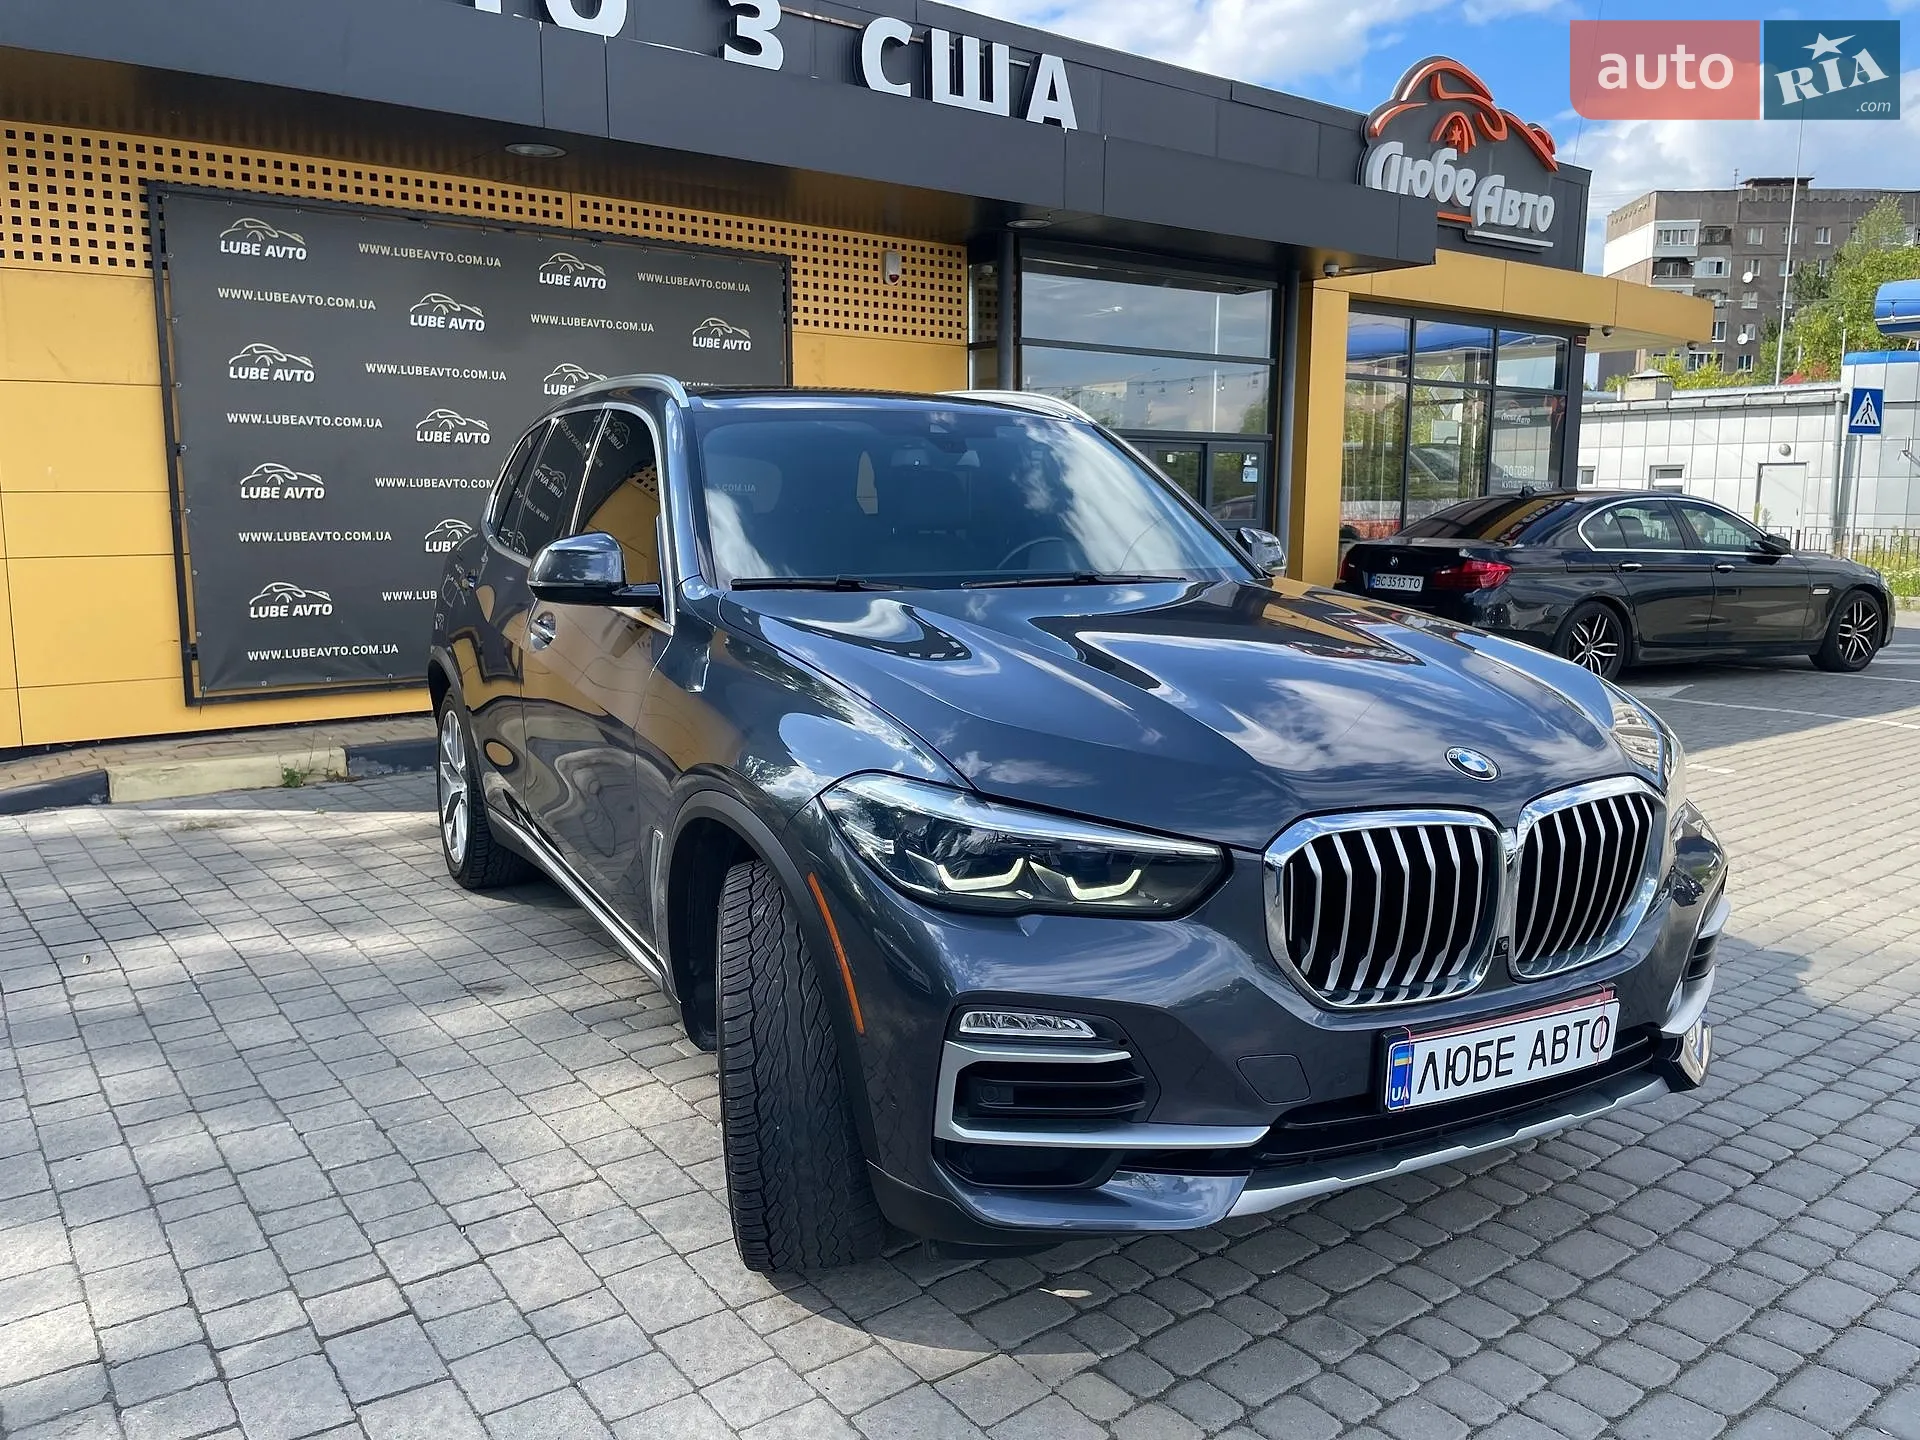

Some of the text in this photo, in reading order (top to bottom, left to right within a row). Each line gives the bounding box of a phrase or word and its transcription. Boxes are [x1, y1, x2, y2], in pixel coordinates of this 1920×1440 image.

[861, 17, 1077, 130] США
[220, 240, 307, 260] LUBE AVTO
[359, 243, 501, 267] WWW.LUBEAVTO.COM.UA
[539, 272, 606, 290] LUBE AVTO
[638, 272, 750, 292] WWW.LUBEAVTO.COM.UA
[218, 287, 376, 310] WWW.LUBEAVTO.COM.UA
[410, 314, 485, 331] LUBE AVTO
[531, 314, 654, 332] WWW.LUBEAVTO.COM.UA
[692, 337, 751, 351] LUBE AVTO
[229, 366, 314, 382] LUBE AVTO
[366, 363, 506, 381] WWW.LUBEAVTO.COM.UA
[227, 413, 383, 428] WWW.LUBEAVTO.COM.UA
[417, 431, 490, 444] LUBE AVTO
[375, 477, 494, 489] WWW.LUBEAVTO.COM
[241, 487, 324, 499] LUBE AVTO
[239, 531, 392, 542] WWW.LUBEAVTO.COM.UA
[250, 604, 332, 618] LUBE AVTO
[248, 644, 398, 661] WWW.LUBEAVTO.COM.UA
[1417, 1015, 1610, 1094] ЛЮБЕ АВТО
[1391, 1086, 1410, 1102] UA
